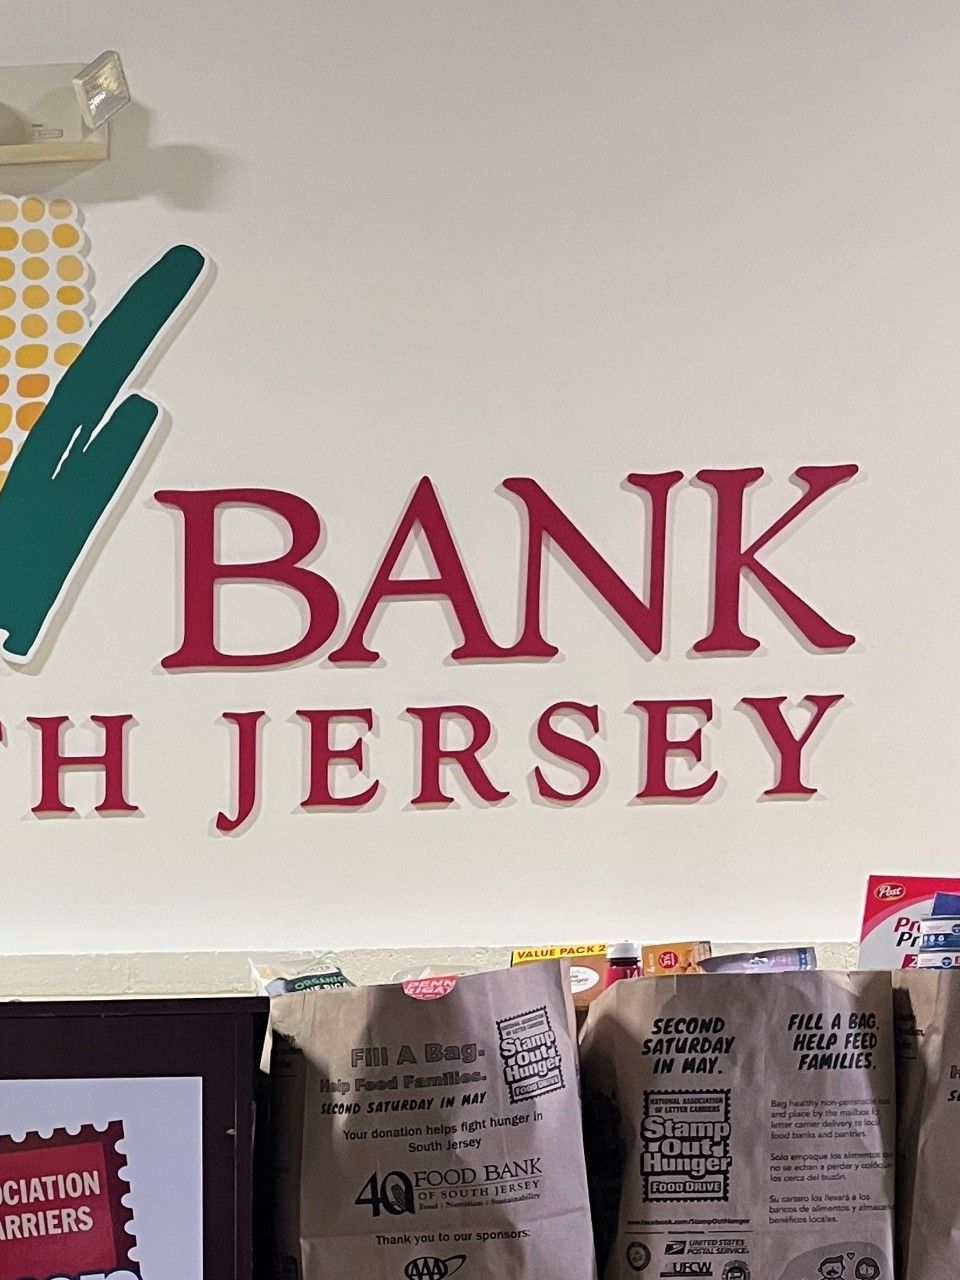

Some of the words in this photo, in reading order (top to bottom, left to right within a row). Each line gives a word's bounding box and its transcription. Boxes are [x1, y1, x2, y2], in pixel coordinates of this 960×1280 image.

[155, 463, 858, 673] BANK
[216, 694, 844, 834] JERSEY
[879, 885, 902, 897] Post
[517, 948, 556, 960] VALUE
[560, 946, 595, 956] PACK
[651, 1018, 725, 1035] SECOND
[788, 1014, 823, 1031] FILL
[831, 1013, 841, 1030] A
[848, 1013, 880, 1030] BAG.
[641, 1036, 736, 1055] SATURDAY
[793, 1033, 838, 1051] HELP
[844, 1033, 877, 1050] FEED
[351, 1048, 389, 1068] Fill
[397, 1045, 417, 1066] A
[425, 1043, 485, 1064] Bag.
[798, 1052, 877, 1071] FAMILIES.
[653, 1057, 673, 1075] IN
[681, 1057, 723, 1075] MAY.
[344, 1129, 368, 1141] Your
[372, 1125, 423, 1139] donation
[426, 1123, 458, 1137] helps
[461, 1119, 486, 1134] fight
[490, 1114, 530, 1130] hunger
[533, 1112, 543, 1121] in
[644, 1116, 730, 1141] Stamp
[408, 1142, 442, 1152] South
[446, 1137, 482, 1151] Jersey
[662, 1138, 713, 1156] Out
[414, 1168, 477, 1187] FOOD
[483, 1158, 542, 1181] BANK
[643, 1153, 731, 1176] Hunger
[652, 1182, 686, 1193] FOOD
[687, 1182, 721, 1193] DRIVE
